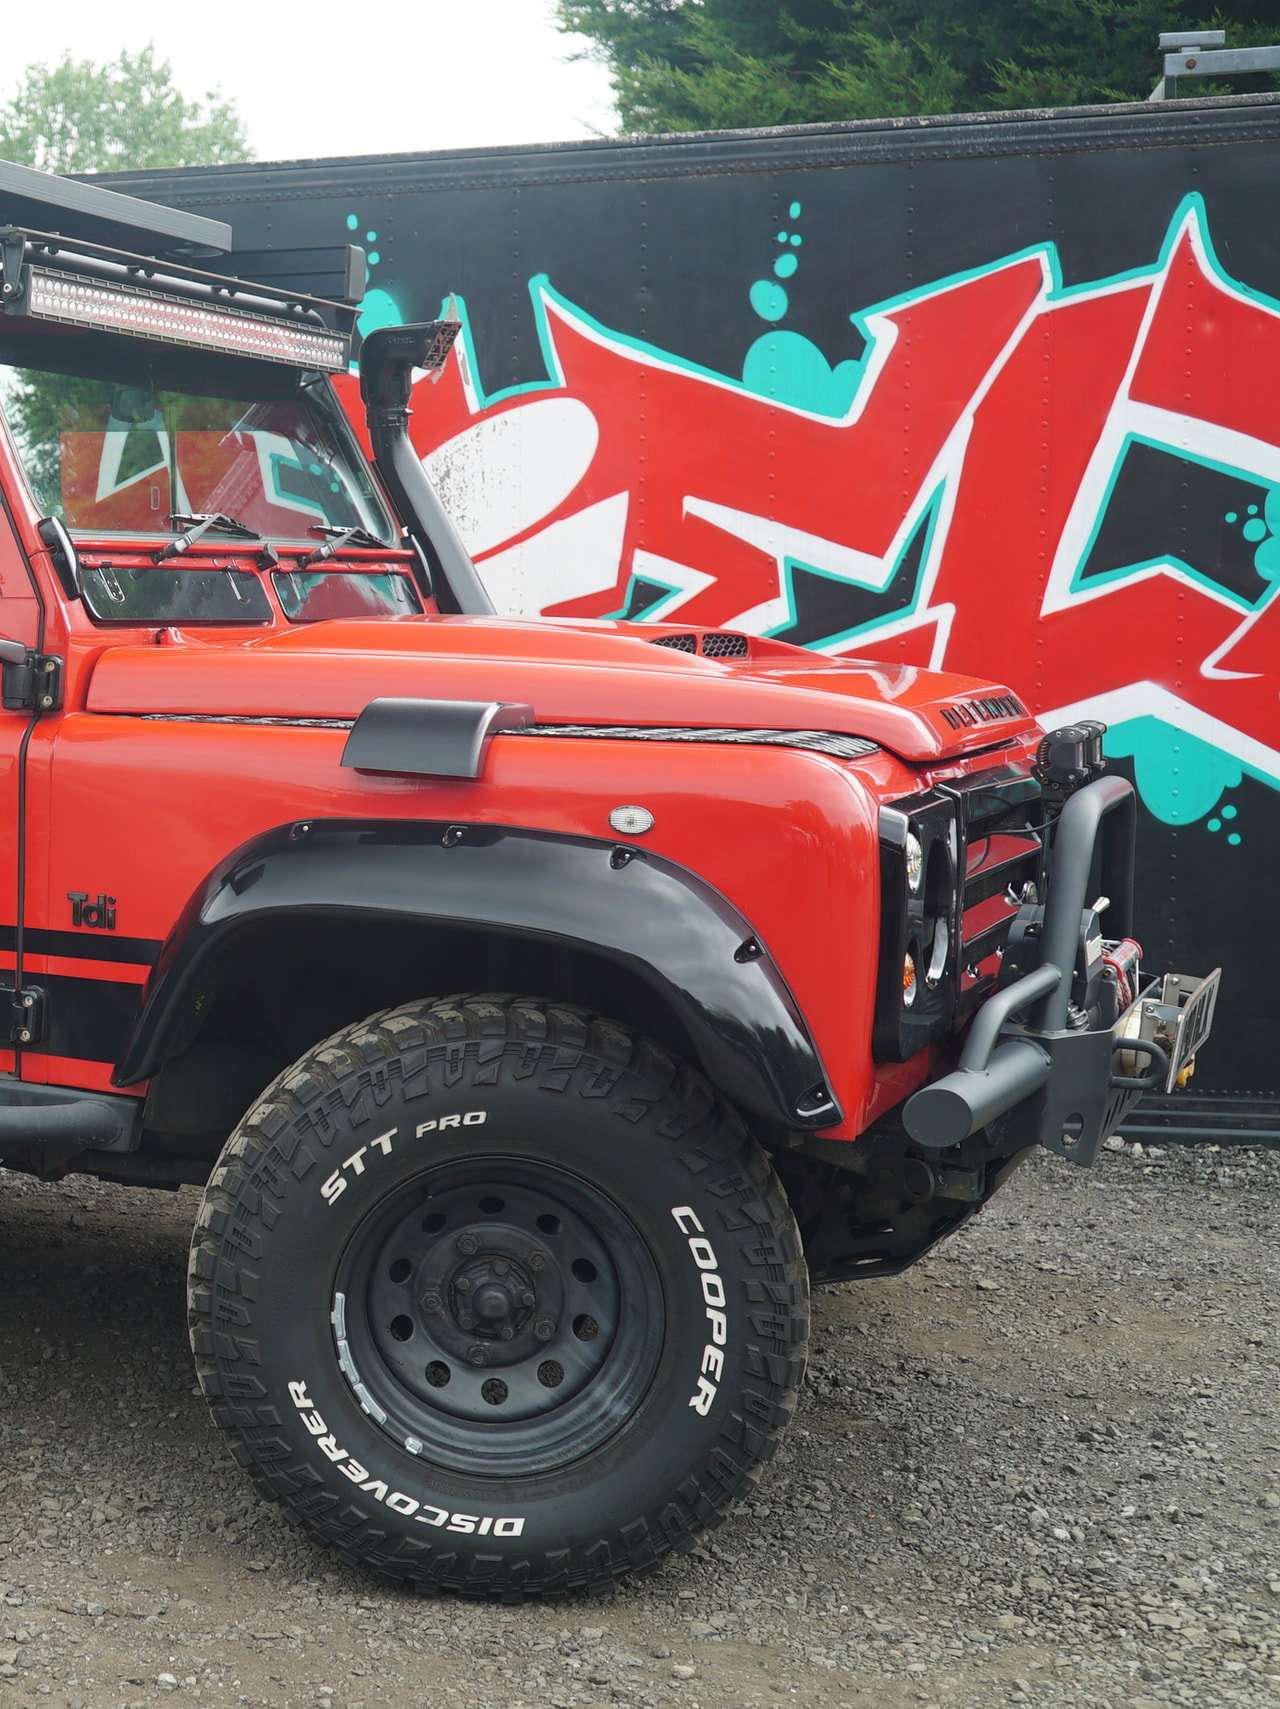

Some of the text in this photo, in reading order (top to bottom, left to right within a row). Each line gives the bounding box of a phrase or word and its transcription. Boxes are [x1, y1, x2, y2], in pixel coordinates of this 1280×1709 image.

[67, 892, 116, 929] Tdi
[320, 1111, 487, 1206] STT PRO
[671, 1206, 727, 1417] COOPER
[287, 1380, 526, 1537] DISCOVERER
